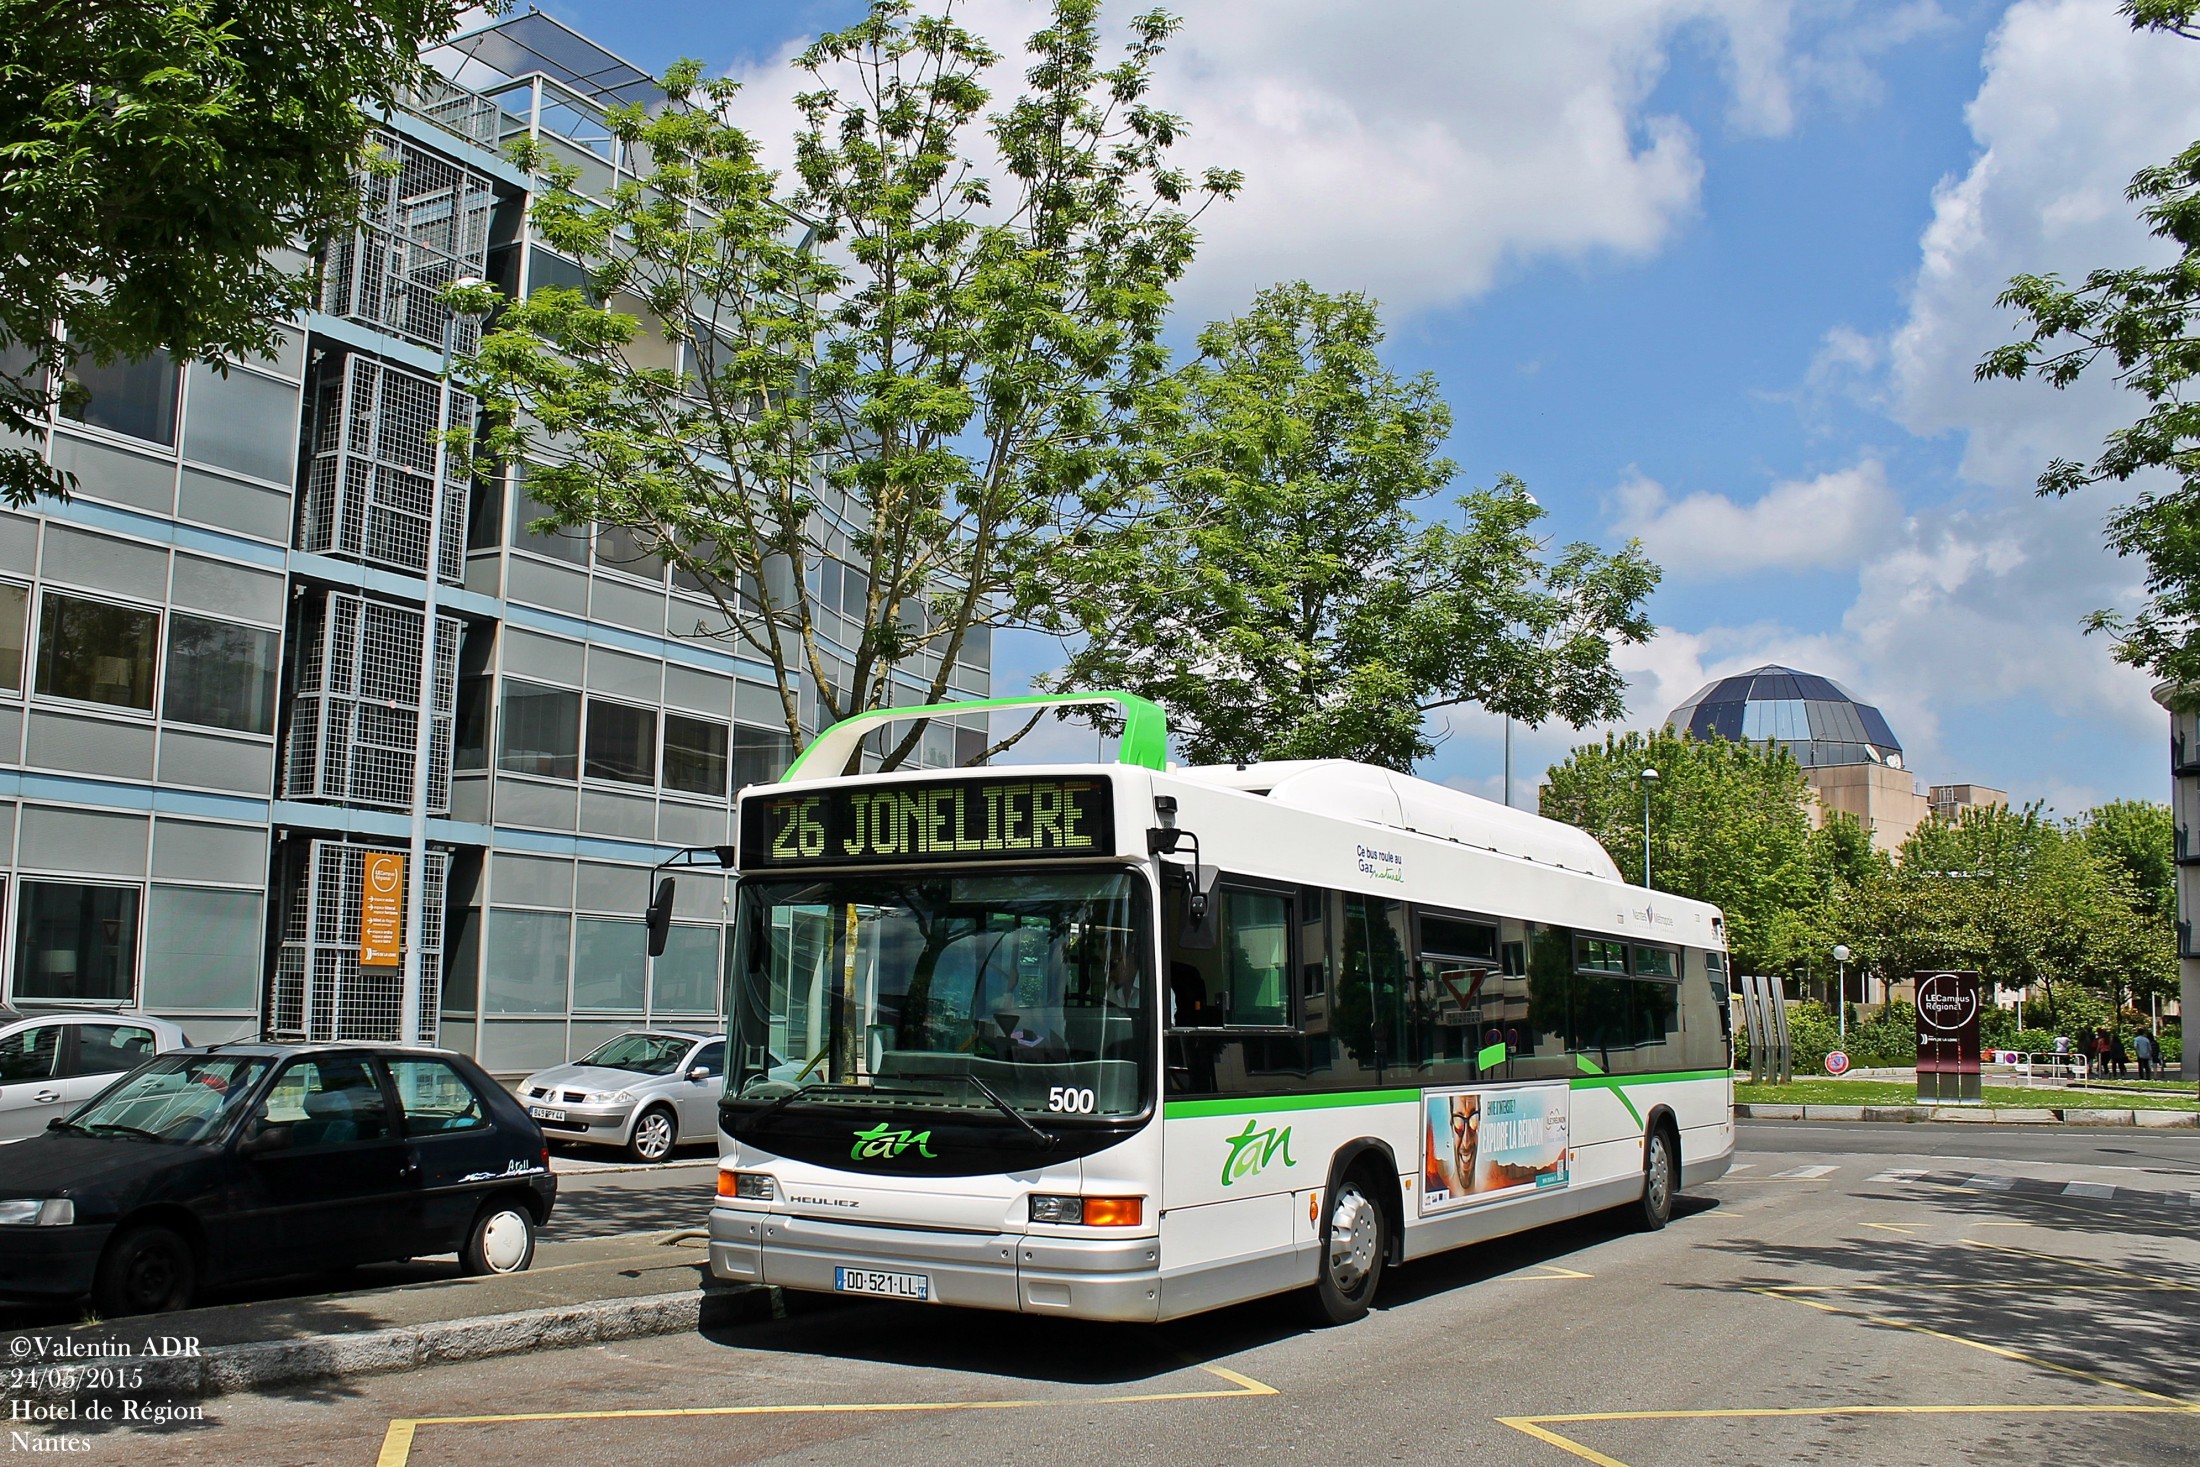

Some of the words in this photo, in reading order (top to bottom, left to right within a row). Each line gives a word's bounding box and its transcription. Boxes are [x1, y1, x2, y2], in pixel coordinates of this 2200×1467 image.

[772, 797, 825, 858] 26
[843, 781, 1093, 855] JONELIERE
[1357, 844, 1366, 858] Ce
[1366, 846, 1378, 860] bus
[1379, 851, 1394, 864] roule
[1395, 855, 1402, 865] au
[1358, 858, 1373, 874] Gaz
[1926, 1002, 1962, 1012] Régional
[1049, 1087, 1095, 1114] 500
[534, 1108, 544, 1118] 849
[556, 1111, 563, 1120] 44
[850, 1122, 938, 1160] tan
[1482, 1121, 1508, 1154] EXPLORE
[1509, 1119, 1517, 1150] LA
[1518, 1112, 1544, 1148] RÉUNION
[1222, 1119, 1297, 1186] tan
[790, 1196, 860, 1208] HEULIEZ
[847, 1272, 917, 1296] DD-521-LL
